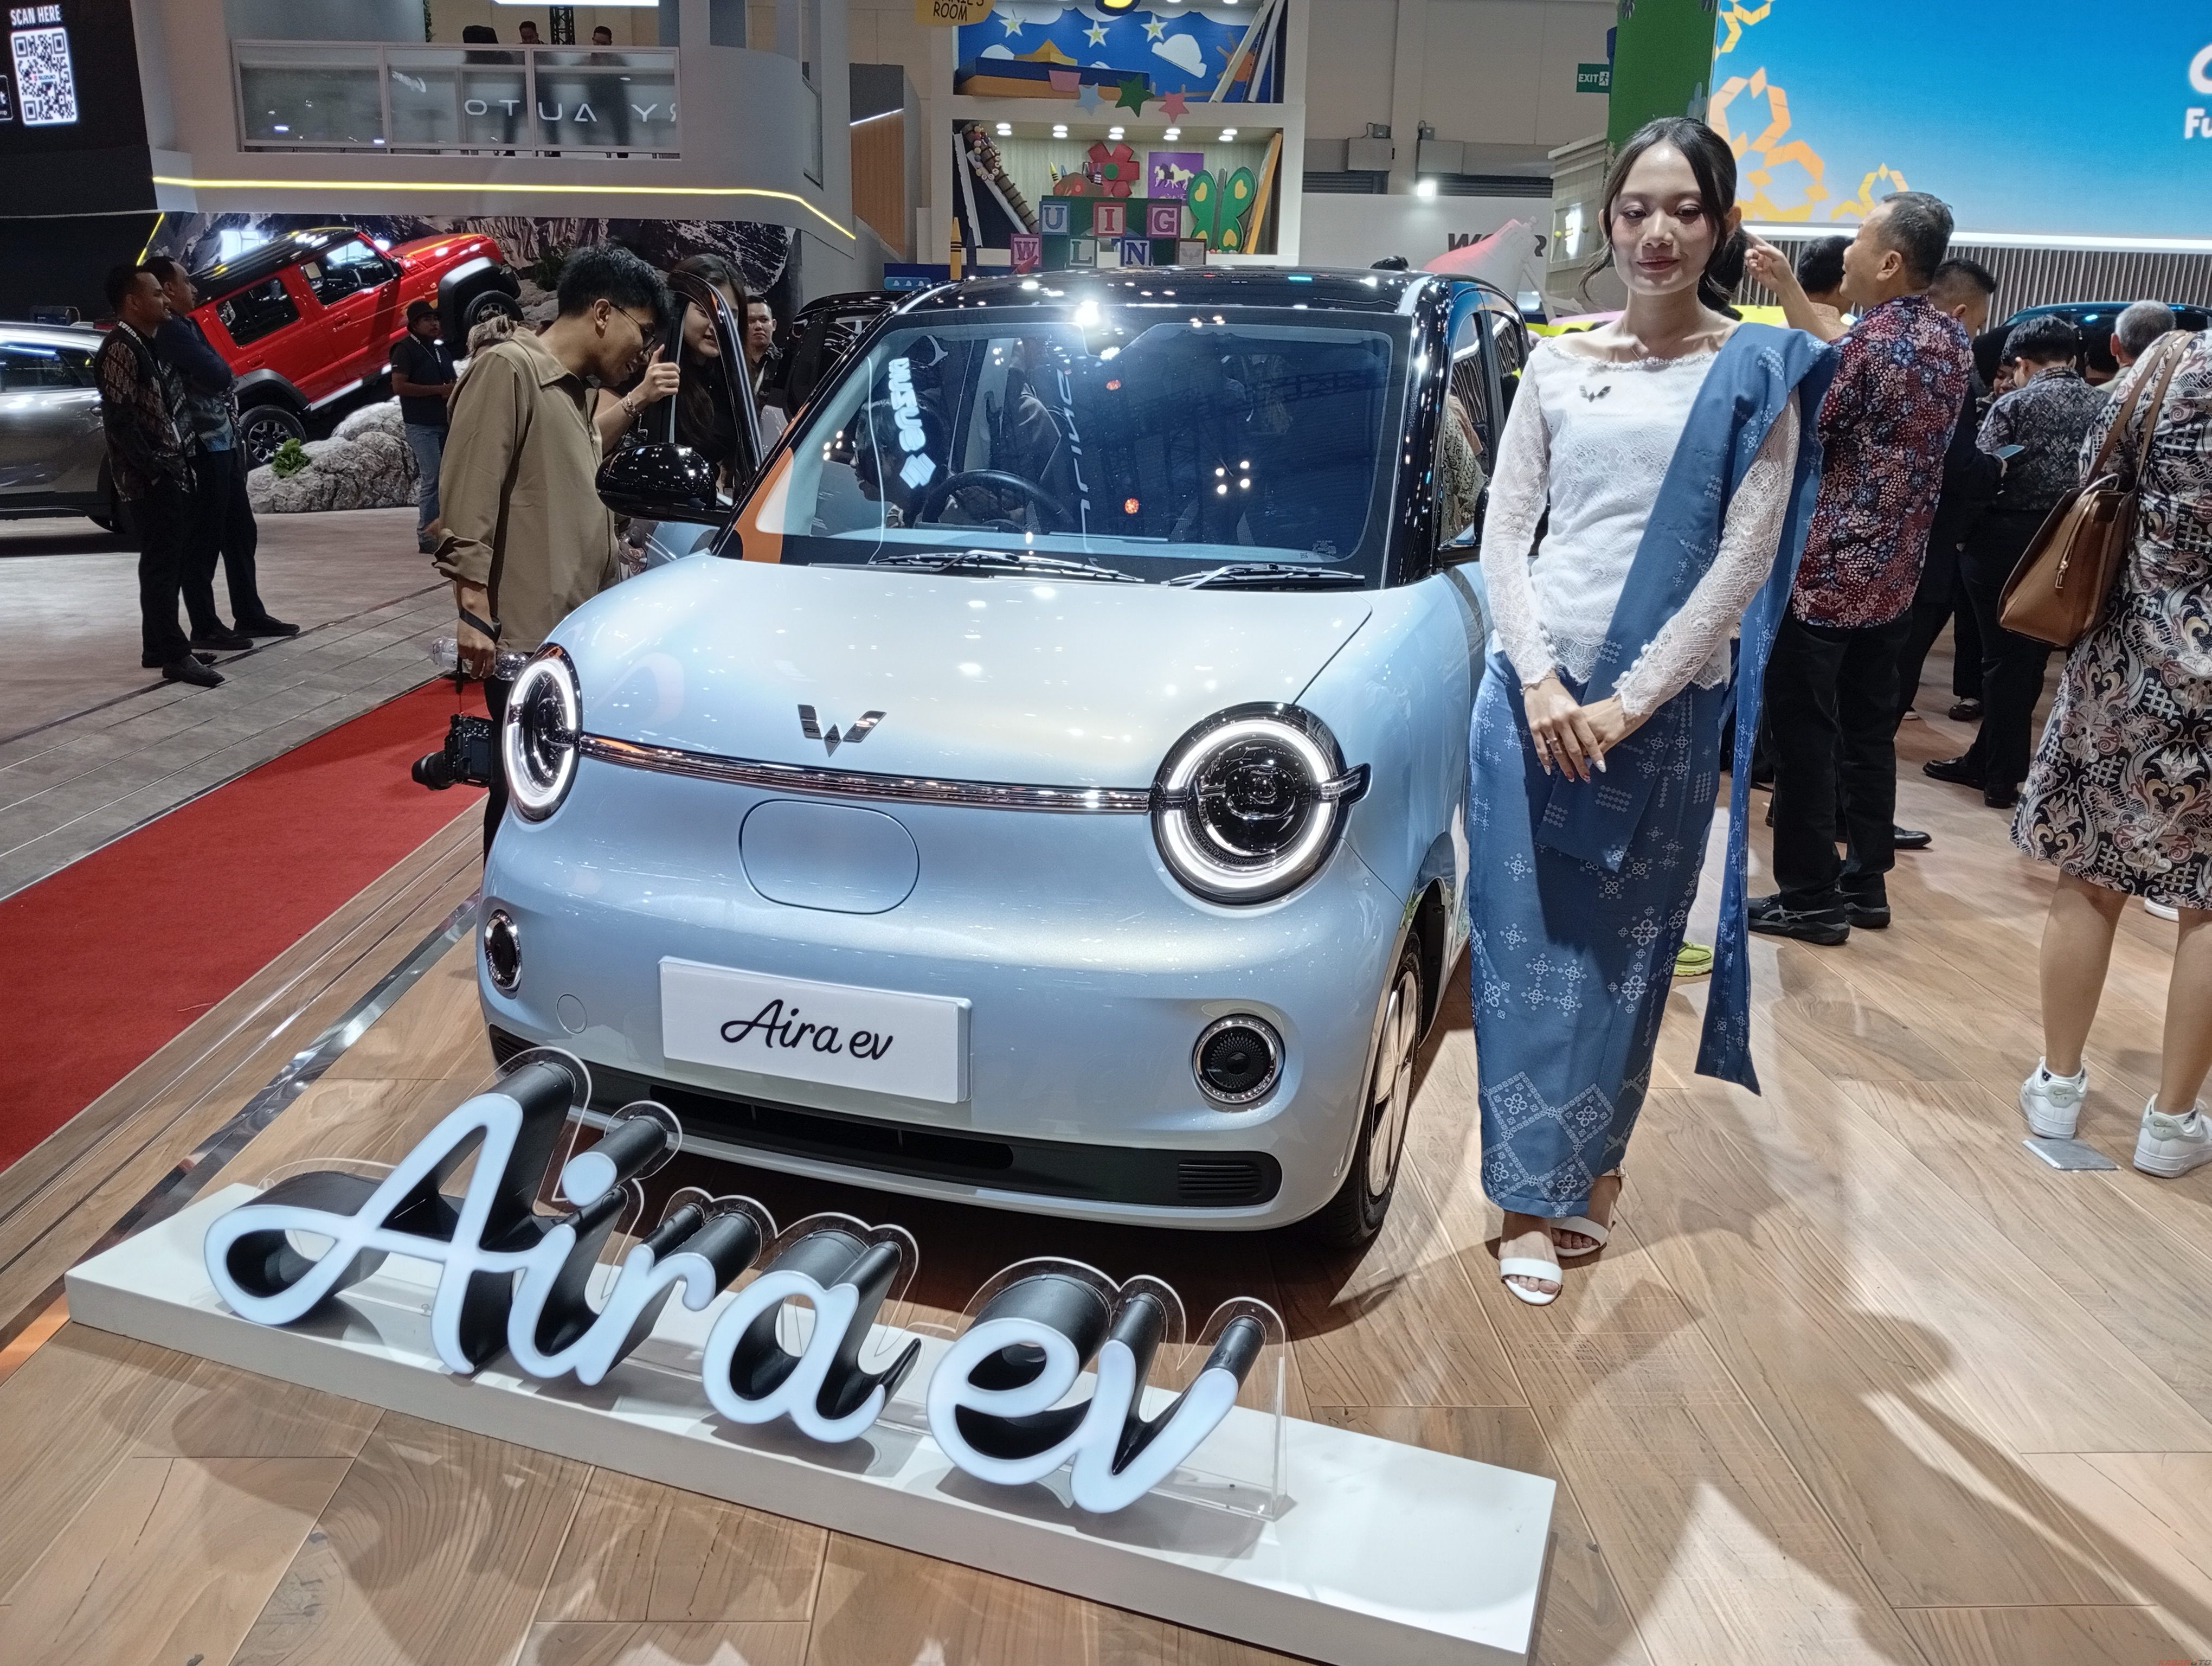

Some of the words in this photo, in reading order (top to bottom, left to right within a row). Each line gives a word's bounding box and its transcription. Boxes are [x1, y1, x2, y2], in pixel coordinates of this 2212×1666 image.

[10, 8, 35, 26] SCAN
[37, 5, 62, 23] HERE
[933, 1, 967, 21] ROOM
[1578, 74, 1599, 82] EXIT
[720, 999, 842, 1054] Aira
[849, 1030, 893, 1060] ev
[204, 1092, 886, 1443] Aira
[926, 1316, 1239, 1514] ev
